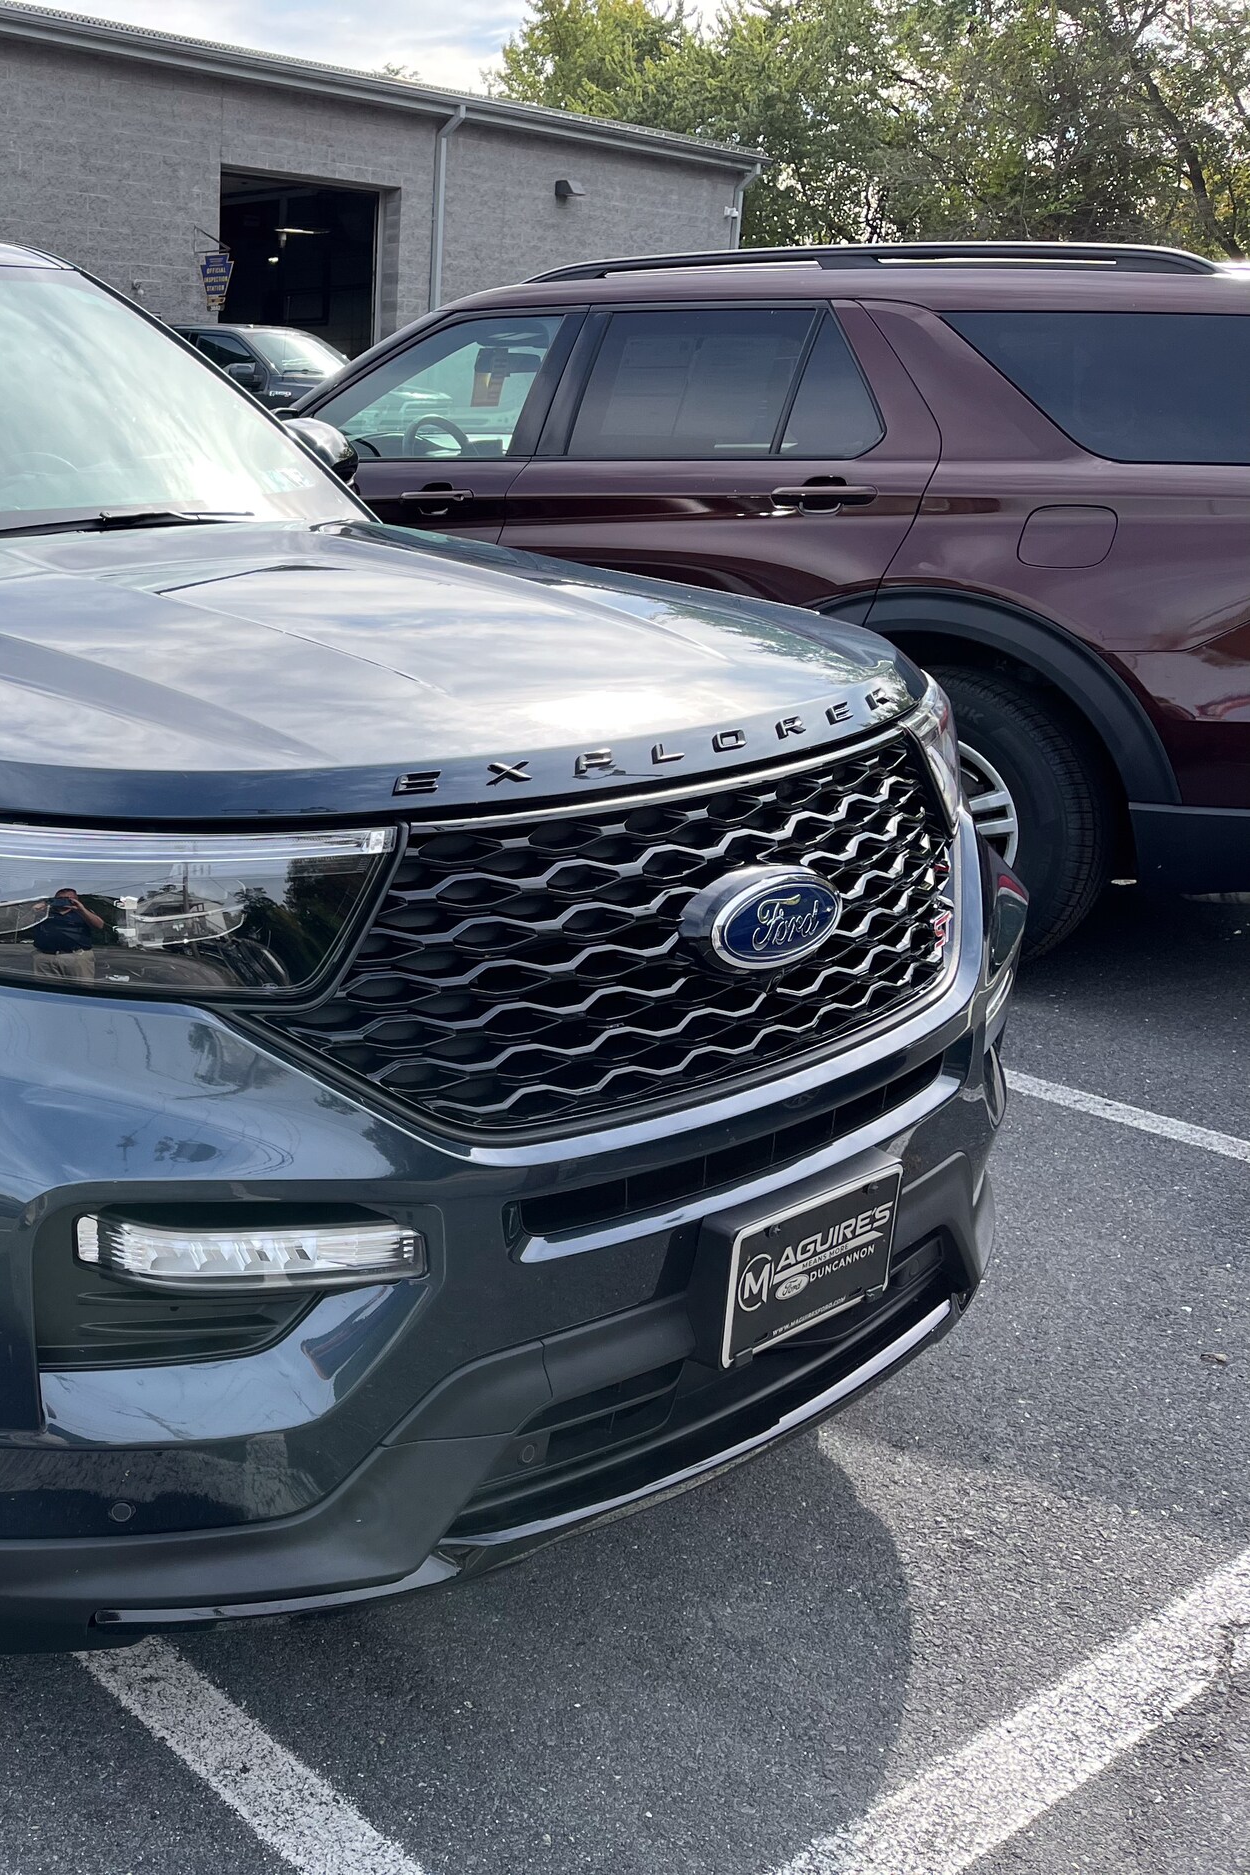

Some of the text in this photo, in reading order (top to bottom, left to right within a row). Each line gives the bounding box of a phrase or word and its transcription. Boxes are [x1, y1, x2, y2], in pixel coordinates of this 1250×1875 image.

[392, 686, 891, 796] EXPLORER
[750, 892, 822, 953] Ford
[801, 1243, 850, 1270] MEANS MORE
[809, 1244, 876, 1283] DUNCANNON
[780, 1277, 805, 1298] Ford
